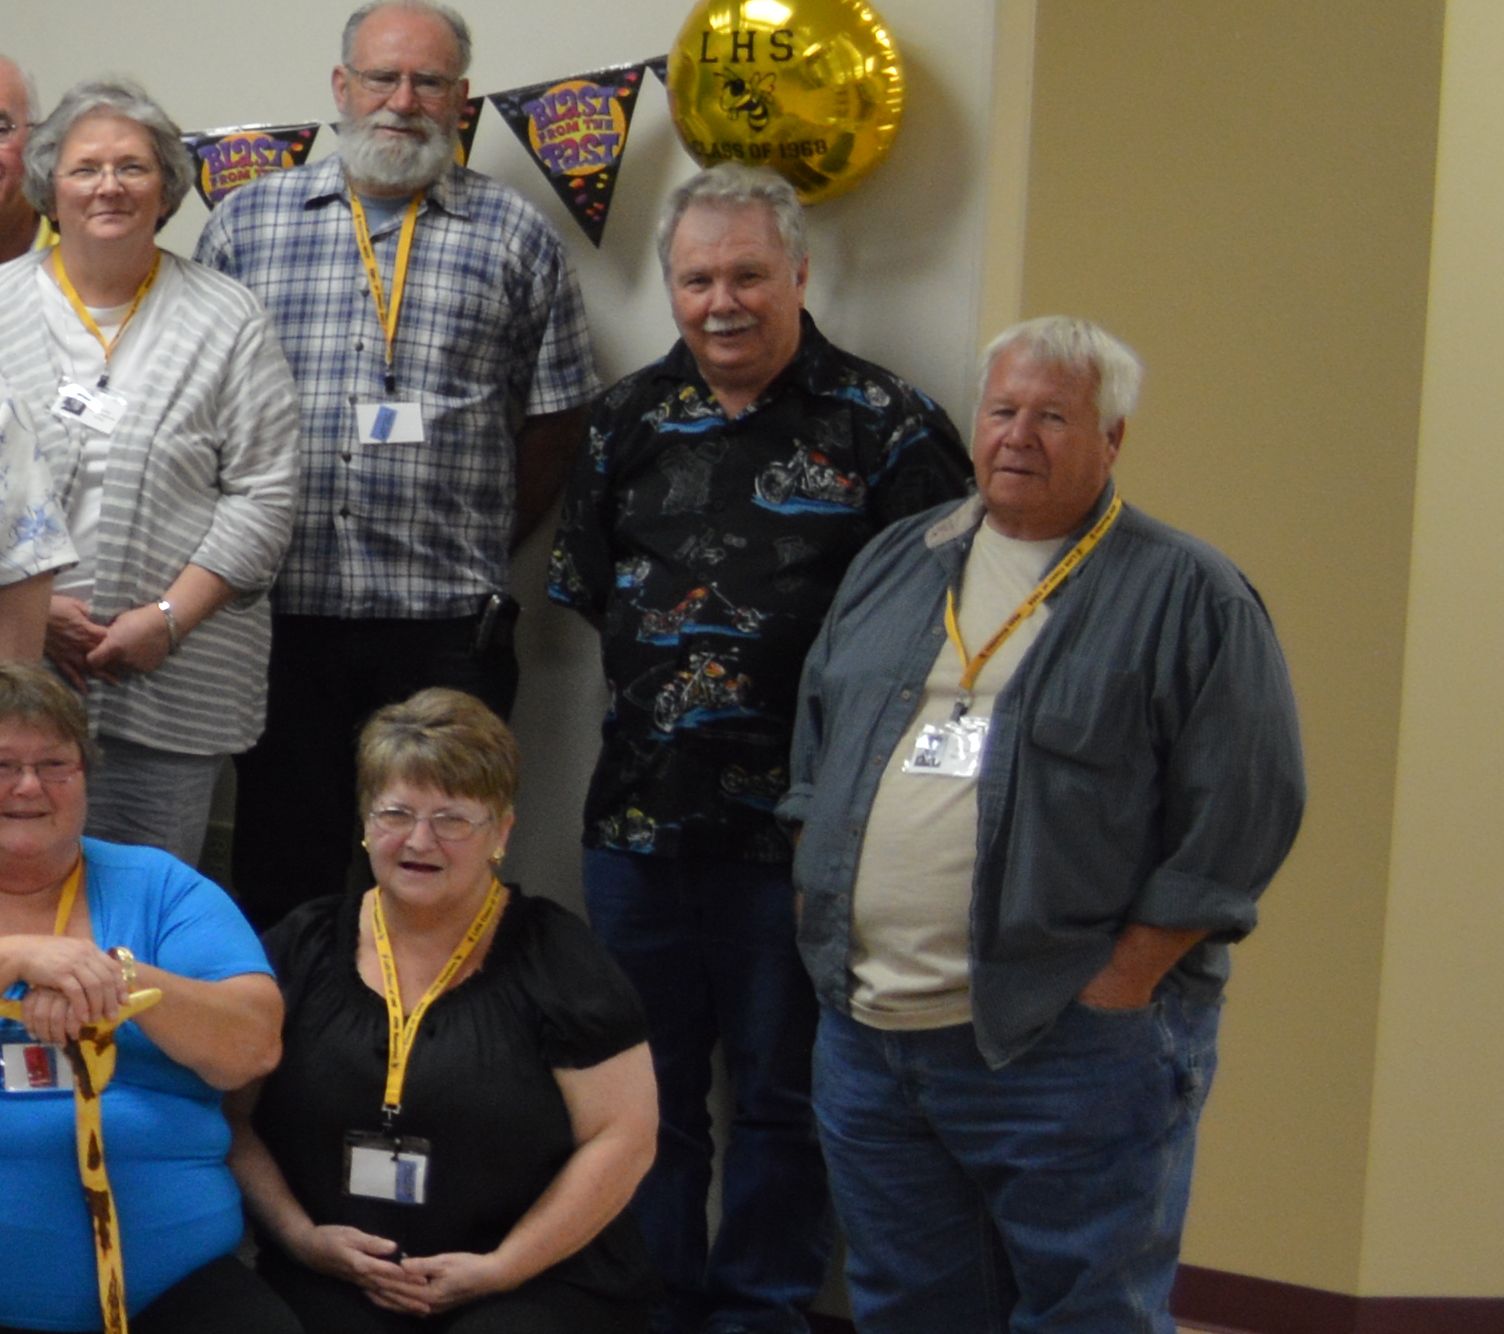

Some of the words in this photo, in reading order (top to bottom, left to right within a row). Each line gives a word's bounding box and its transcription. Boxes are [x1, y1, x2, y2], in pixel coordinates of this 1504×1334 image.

[700, 29, 794, 64] LHS
[749, 141, 772, 159] OF
[778, 138, 828, 159] 1968
